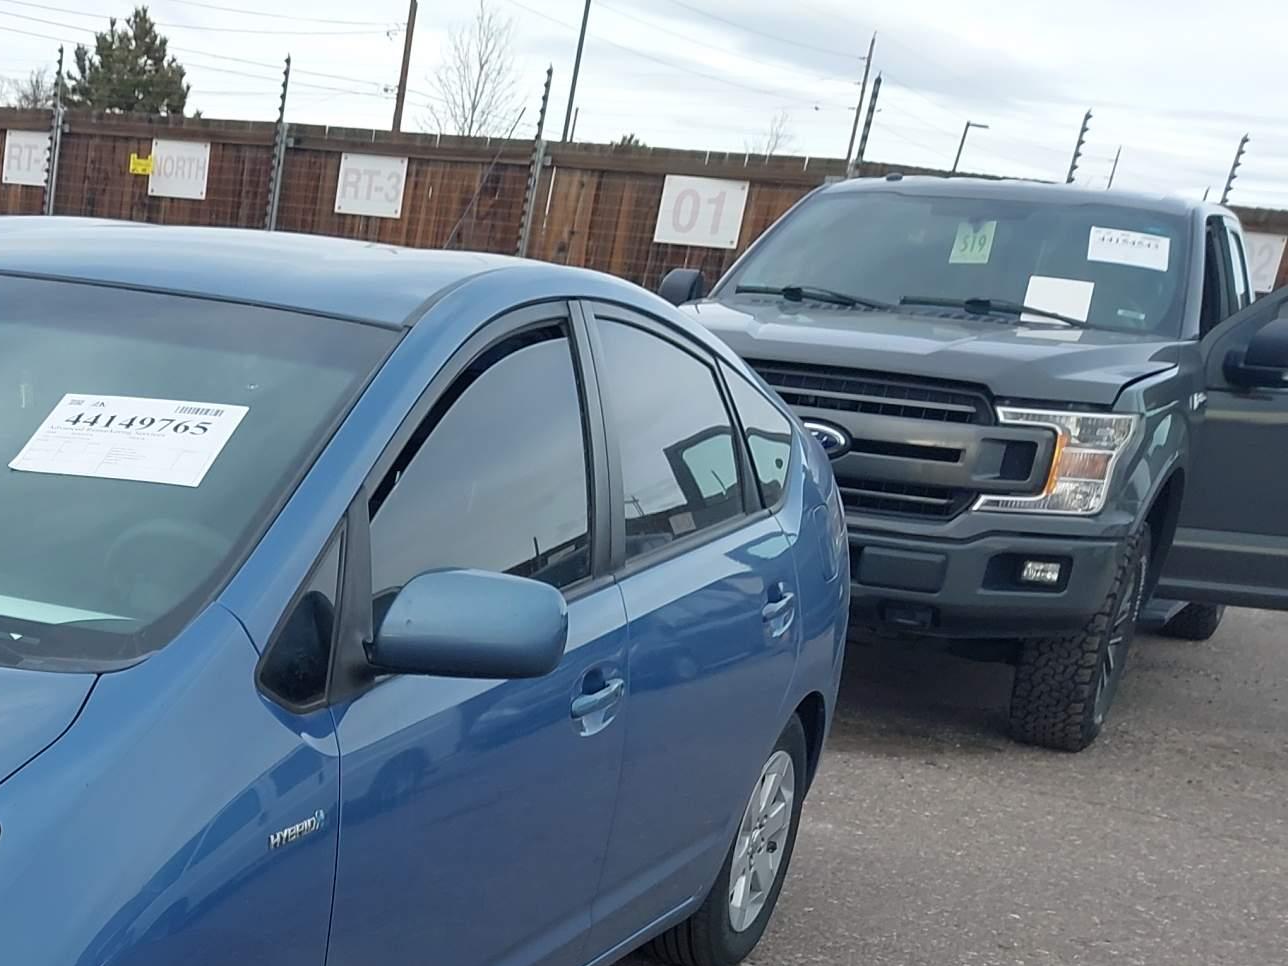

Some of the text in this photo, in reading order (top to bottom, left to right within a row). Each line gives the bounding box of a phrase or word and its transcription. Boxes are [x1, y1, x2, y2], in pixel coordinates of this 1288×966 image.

[153, 154, 207, 181] NORTH
[341, 167, 402, 204] RT-3
[672, 187, 727, 236] 01
[65, 412, 213, 437] 44149765
[269, 815, 317, 850] HYBRID
